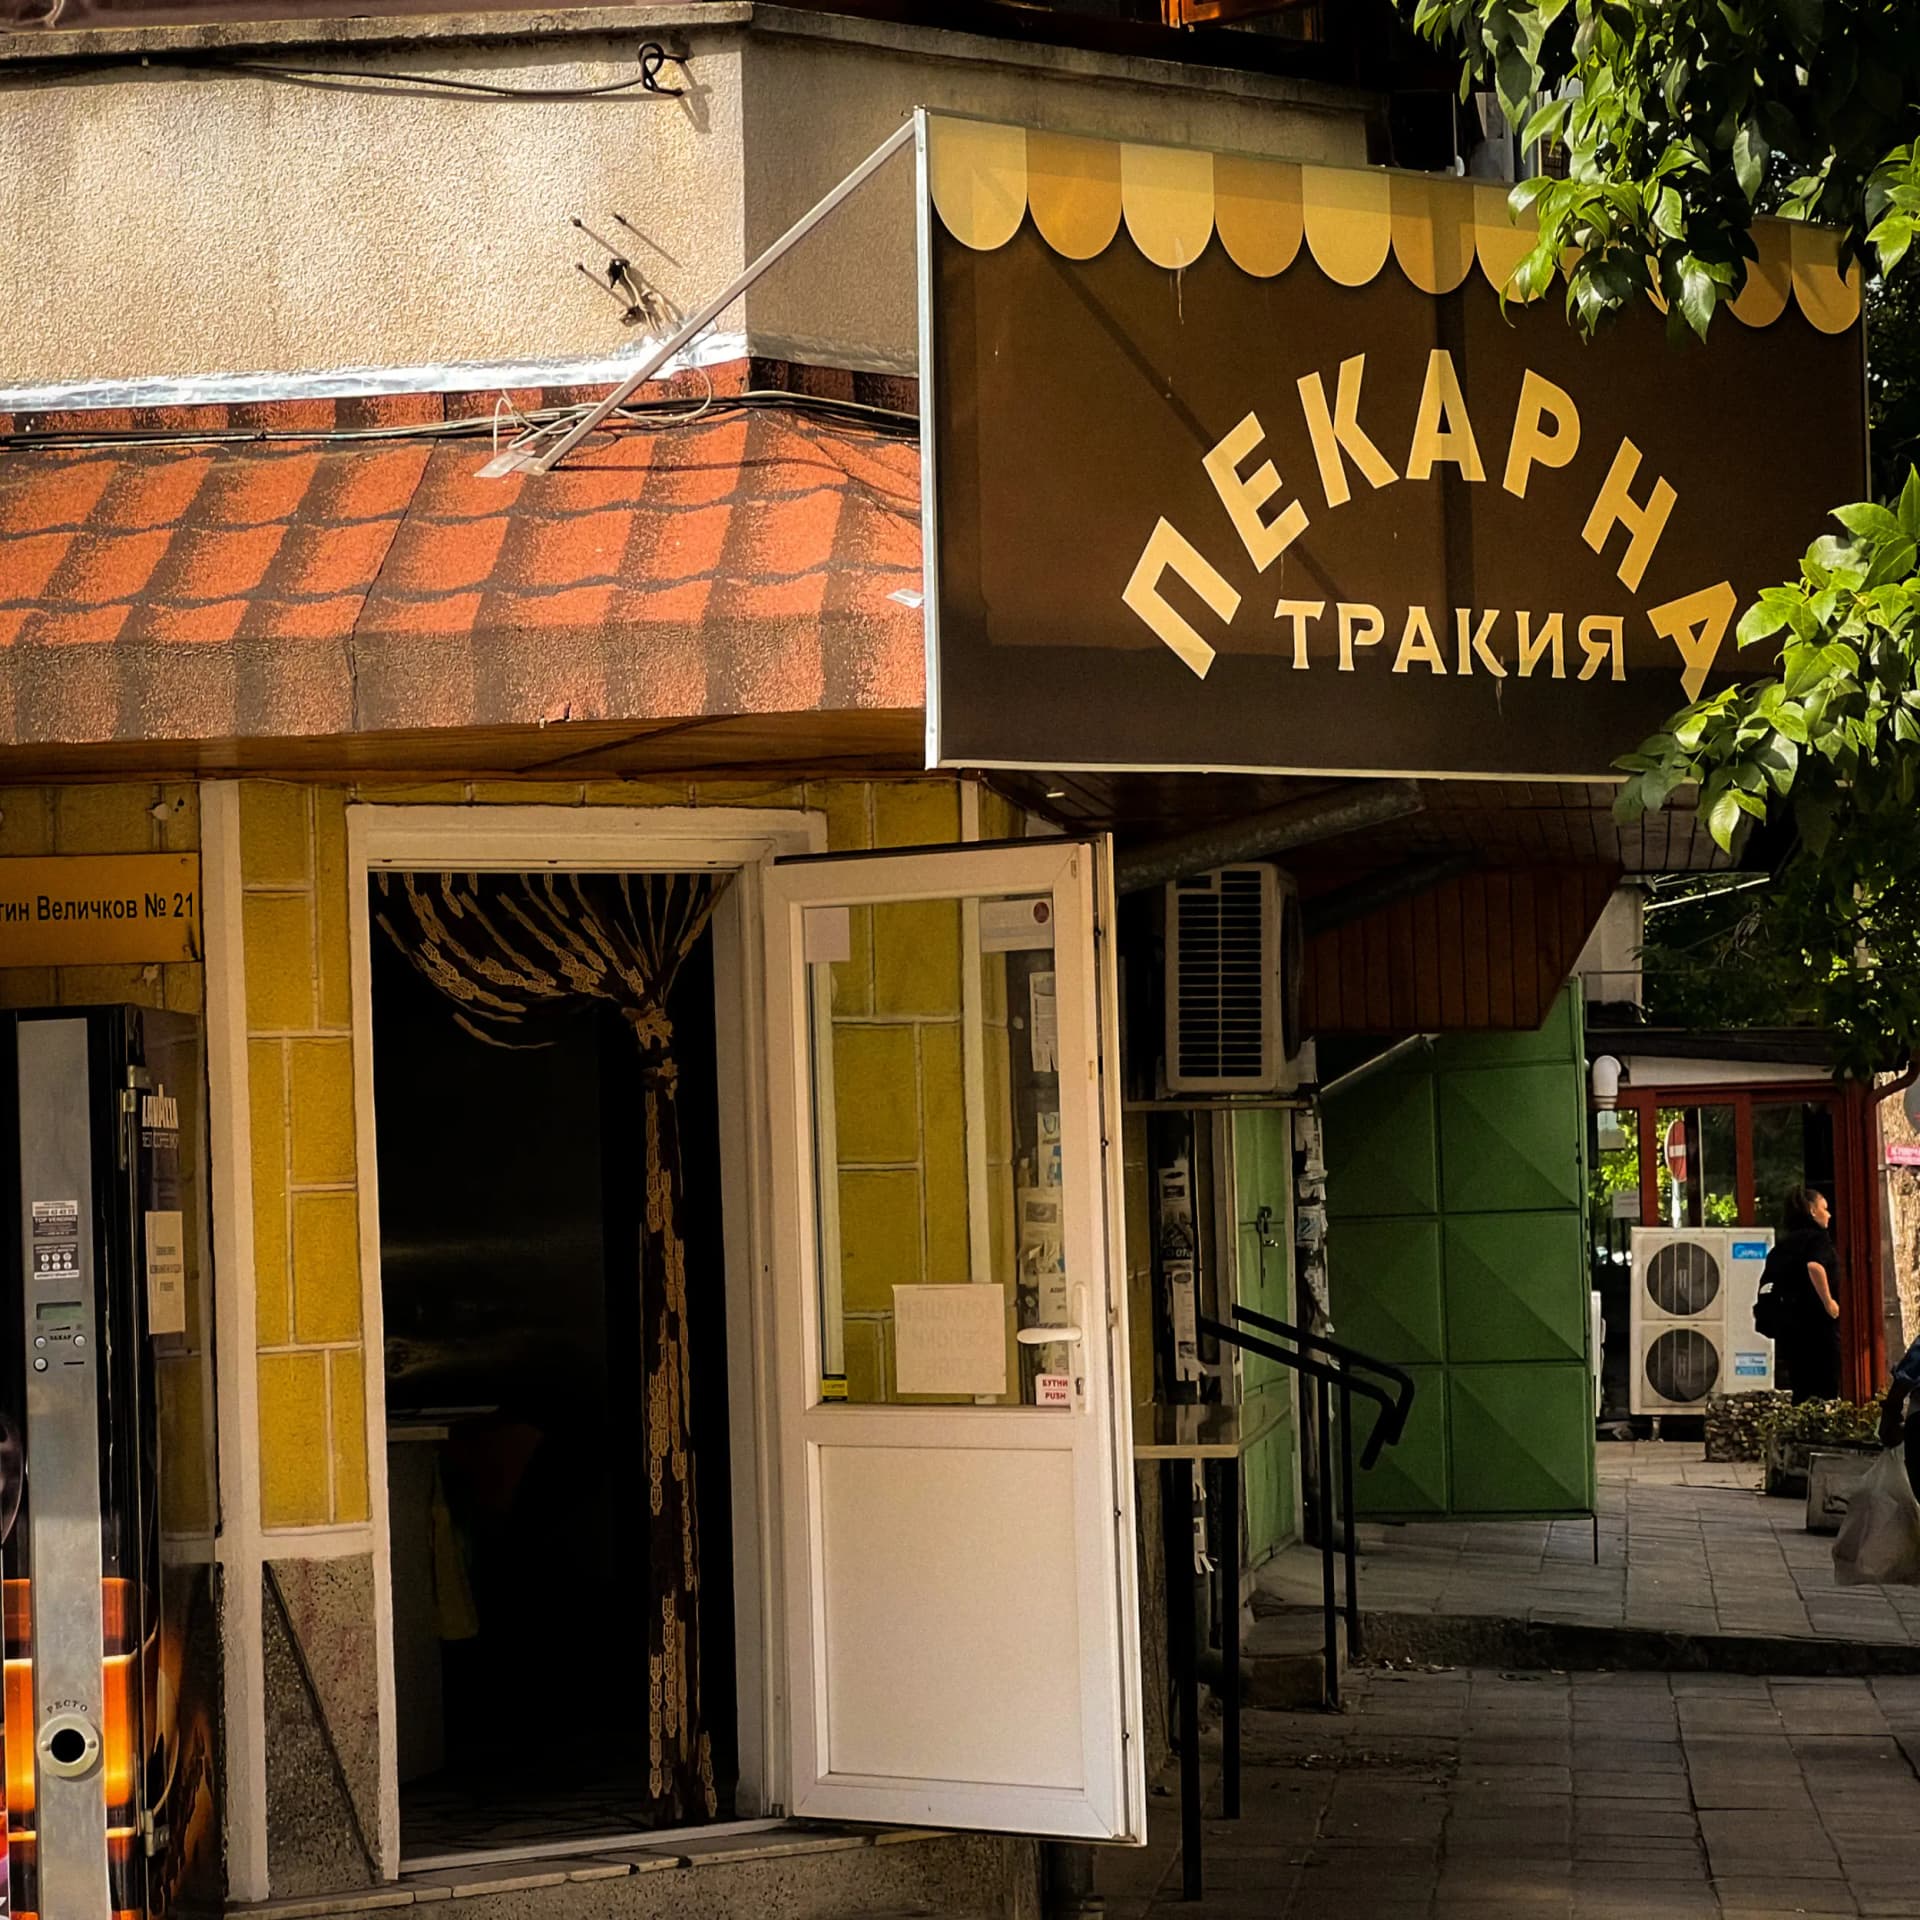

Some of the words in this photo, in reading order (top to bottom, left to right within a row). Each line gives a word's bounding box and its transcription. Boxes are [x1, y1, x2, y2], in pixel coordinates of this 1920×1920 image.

[1121, 348, 1738, 704] ПЕКАРНА
[1274, 598, 1627, 682] ТРАКИЯ
[37, 895, 138, 921] Величков
[144, 892, 166, 918] №
[173, 891, 193, 918] 21
